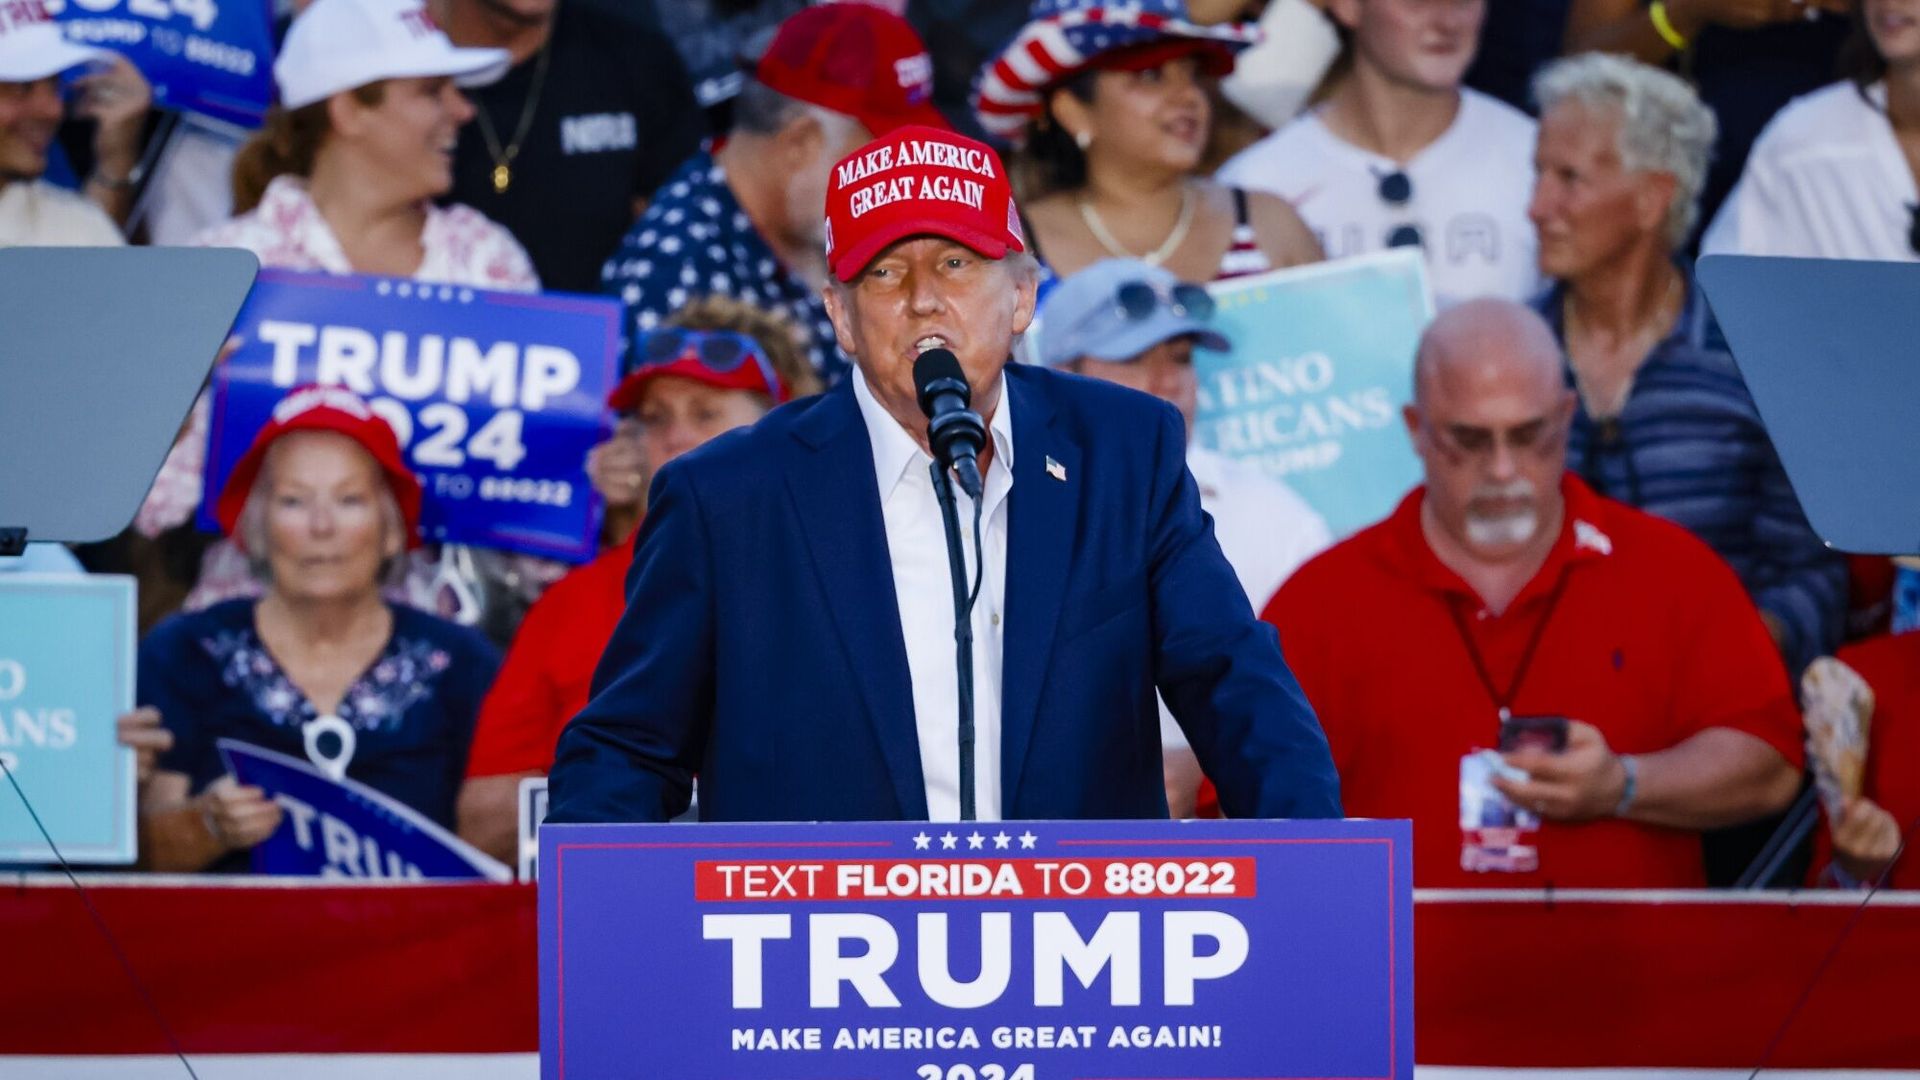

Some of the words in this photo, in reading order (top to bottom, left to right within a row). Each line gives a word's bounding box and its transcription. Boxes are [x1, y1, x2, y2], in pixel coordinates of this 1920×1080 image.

[838, 145, 893, 190] MAKE
[896, 140, 995, 179] AMERICA
[850, 176, 914, 219] GREAT
[918, 175, 984, 211] AGAIN
[258, 320, 581, 411] TRUMP
[273, 790, 424, 881] TRU
[716, 865, 824, 897] TEXT
[836, 862, 1024, 897] FLORIDA
[1034, 862, 1092, 895] TO
[1104, 861, 1236, 895] 88022
[702, 910, 1250, 1009] TRUMP
[731, 1028, 822, 1050] MAKE
[833, 1026, 981, 1050] AMERICA
[991, 1026, 1097, 1048] GREAT
[1107, 1025, 1222, 1048] AGAIN!
